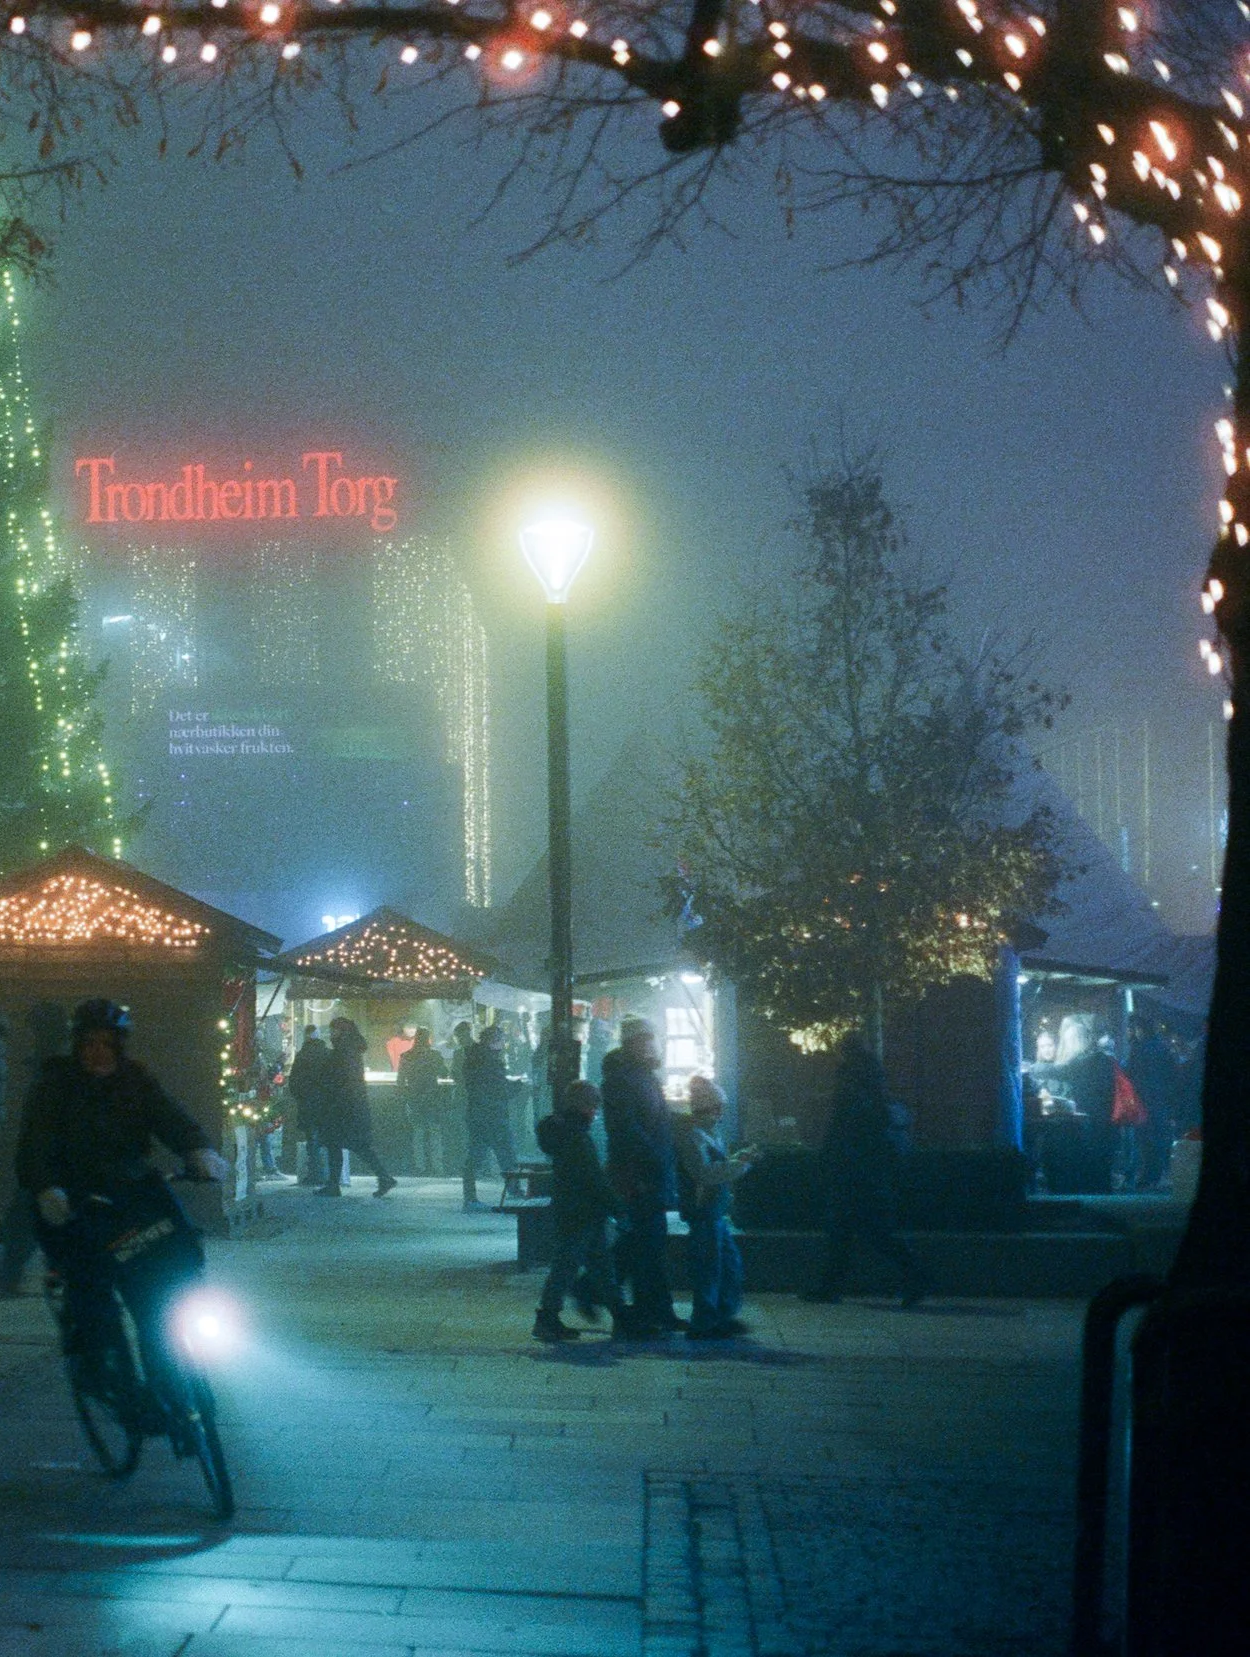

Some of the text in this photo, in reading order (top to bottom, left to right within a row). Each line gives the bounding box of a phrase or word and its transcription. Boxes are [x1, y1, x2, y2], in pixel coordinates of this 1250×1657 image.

[75, 451, 398, 532] Trondheim Torg
[169, 709, 191, 721] Det
[195, 711, 209, 721] er
[169, 724, 280, 738] nærbutikken din
